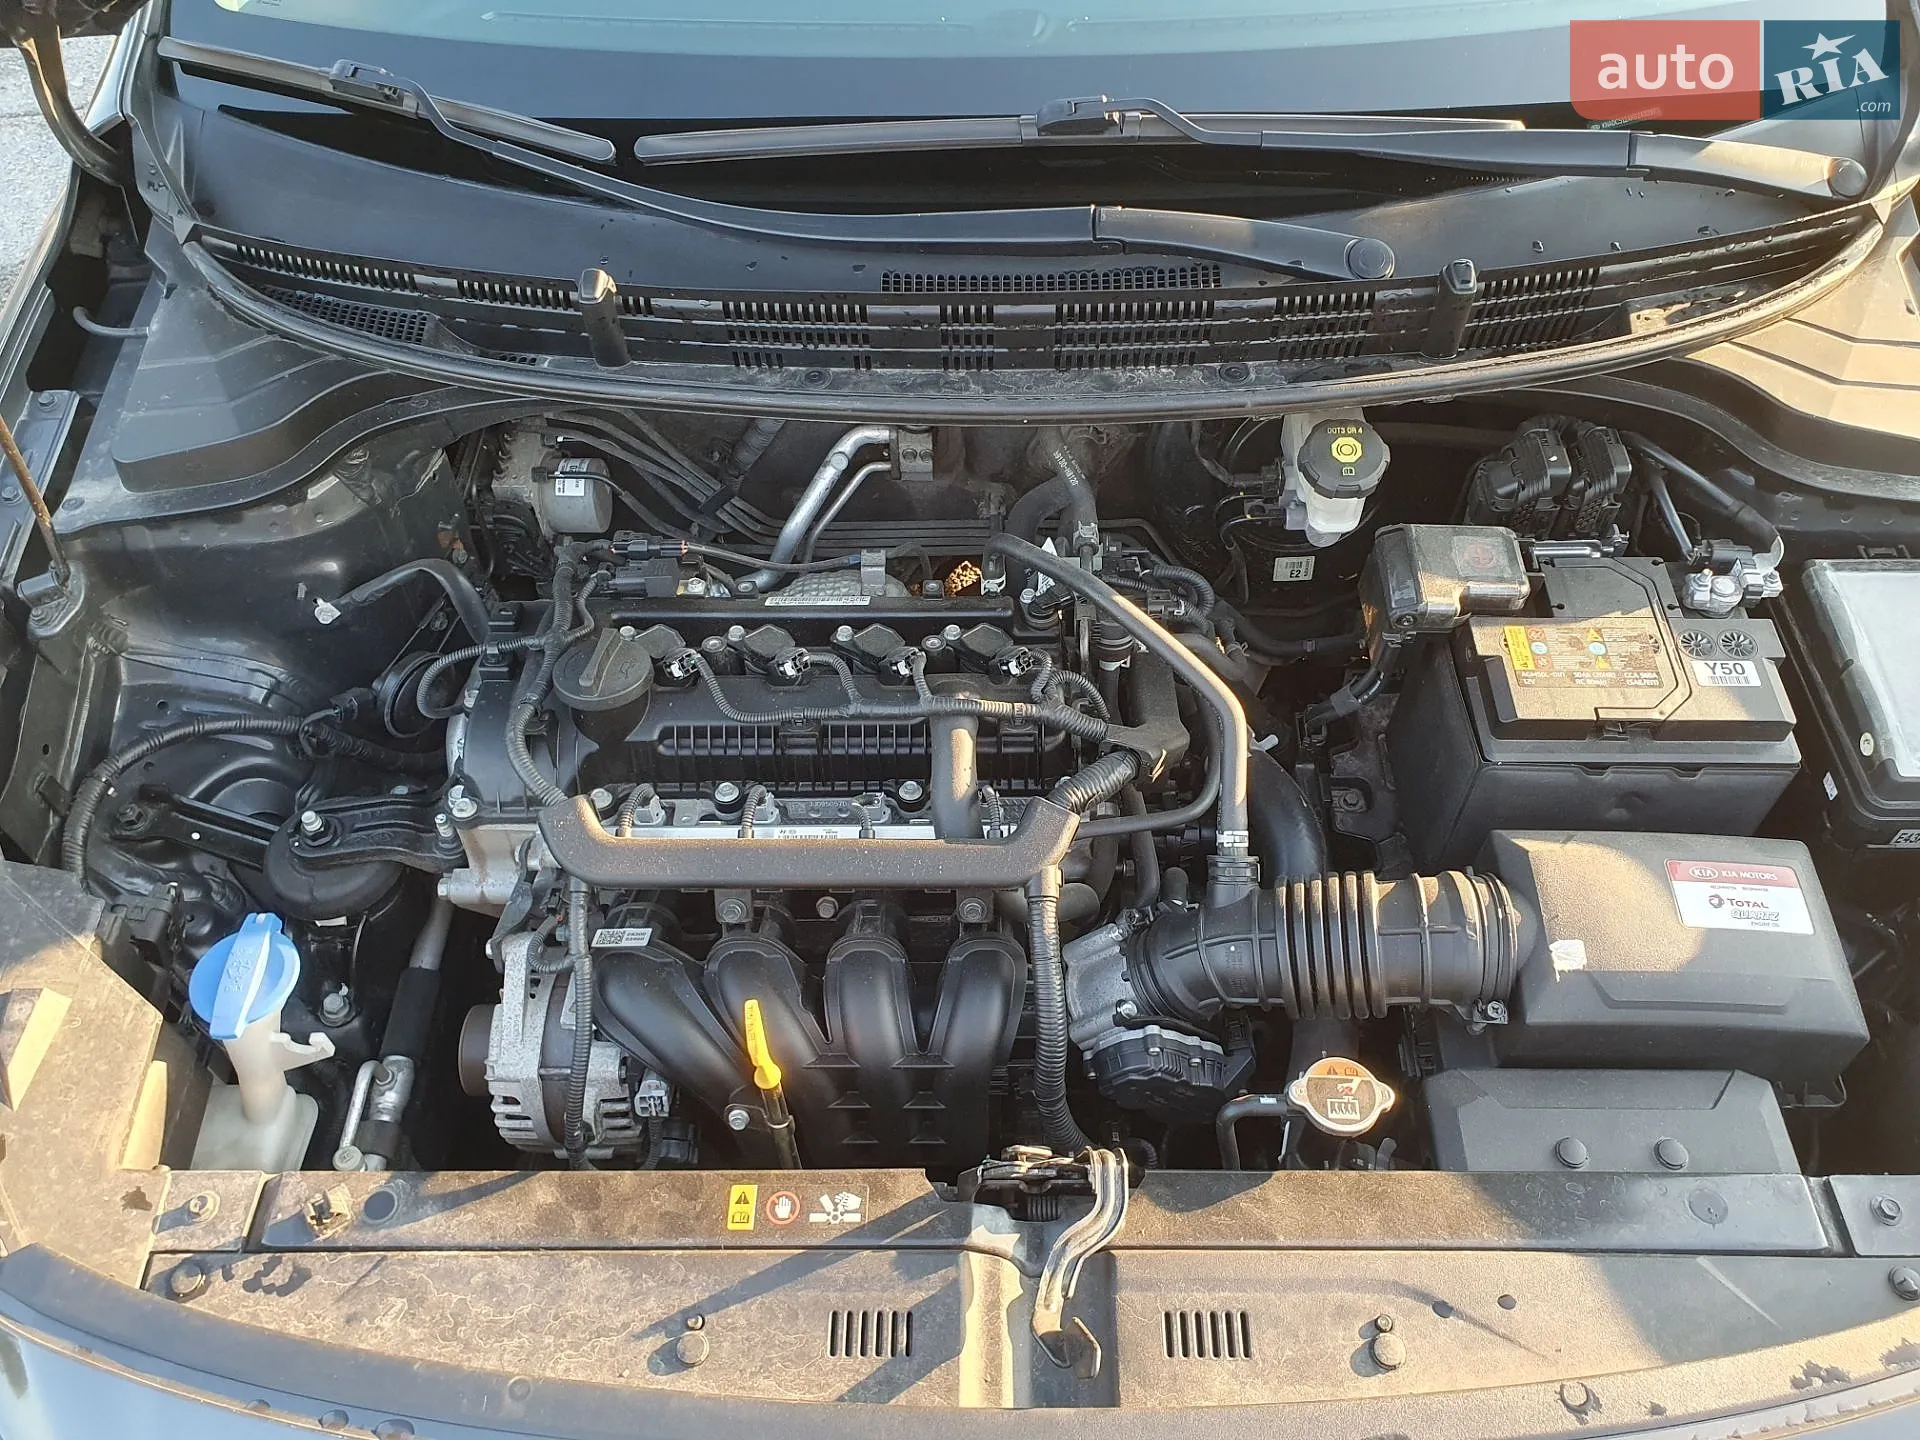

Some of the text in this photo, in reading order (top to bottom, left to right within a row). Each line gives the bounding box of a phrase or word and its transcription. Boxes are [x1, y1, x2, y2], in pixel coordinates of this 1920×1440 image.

[1704, 662, 1746, 676] Y50
[1693, 868, 1714, 877] KIA
[1740, 871, 1778, 880] MOTORS
[1727, 897, 1769, 909] TOTAL
[1731, 909, 1780, 921] QUARTZ
